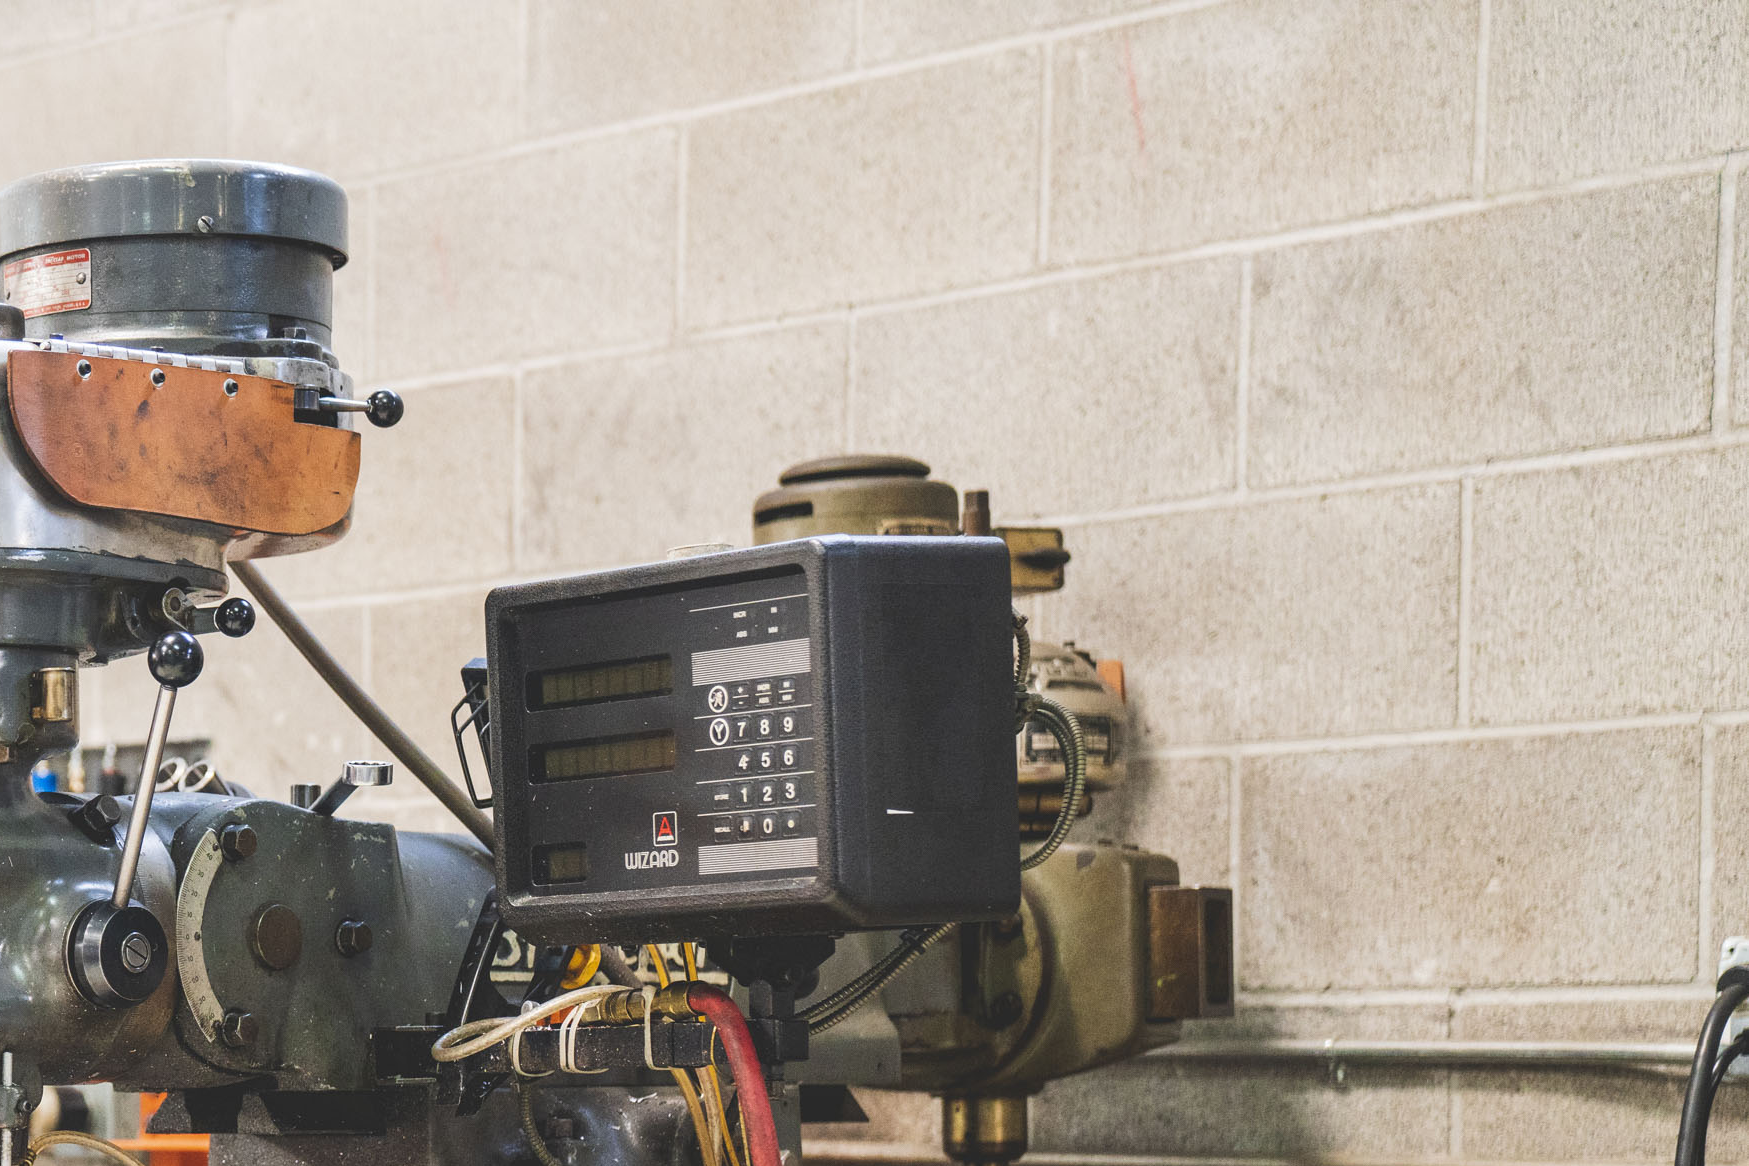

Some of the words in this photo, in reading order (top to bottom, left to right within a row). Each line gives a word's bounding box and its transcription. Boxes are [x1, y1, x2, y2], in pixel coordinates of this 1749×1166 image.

[714, 724, 723, 740] Y
[737, 721, 746, 737] 7
[759, 718, 770, 735] 8
[783, 716, 793, 732] 9
[738, 754, 750, 770] 4
[761, 751, 771, 767] 5
[783, 749, 794, 766] 6
[740, 787, 748, 803] 1
[762, 785, 772, 802] 2
[785, 782, 795, 799] 3
[763, 817, 773, 834] 0
[625, 849, 679, 870] WIZARD
